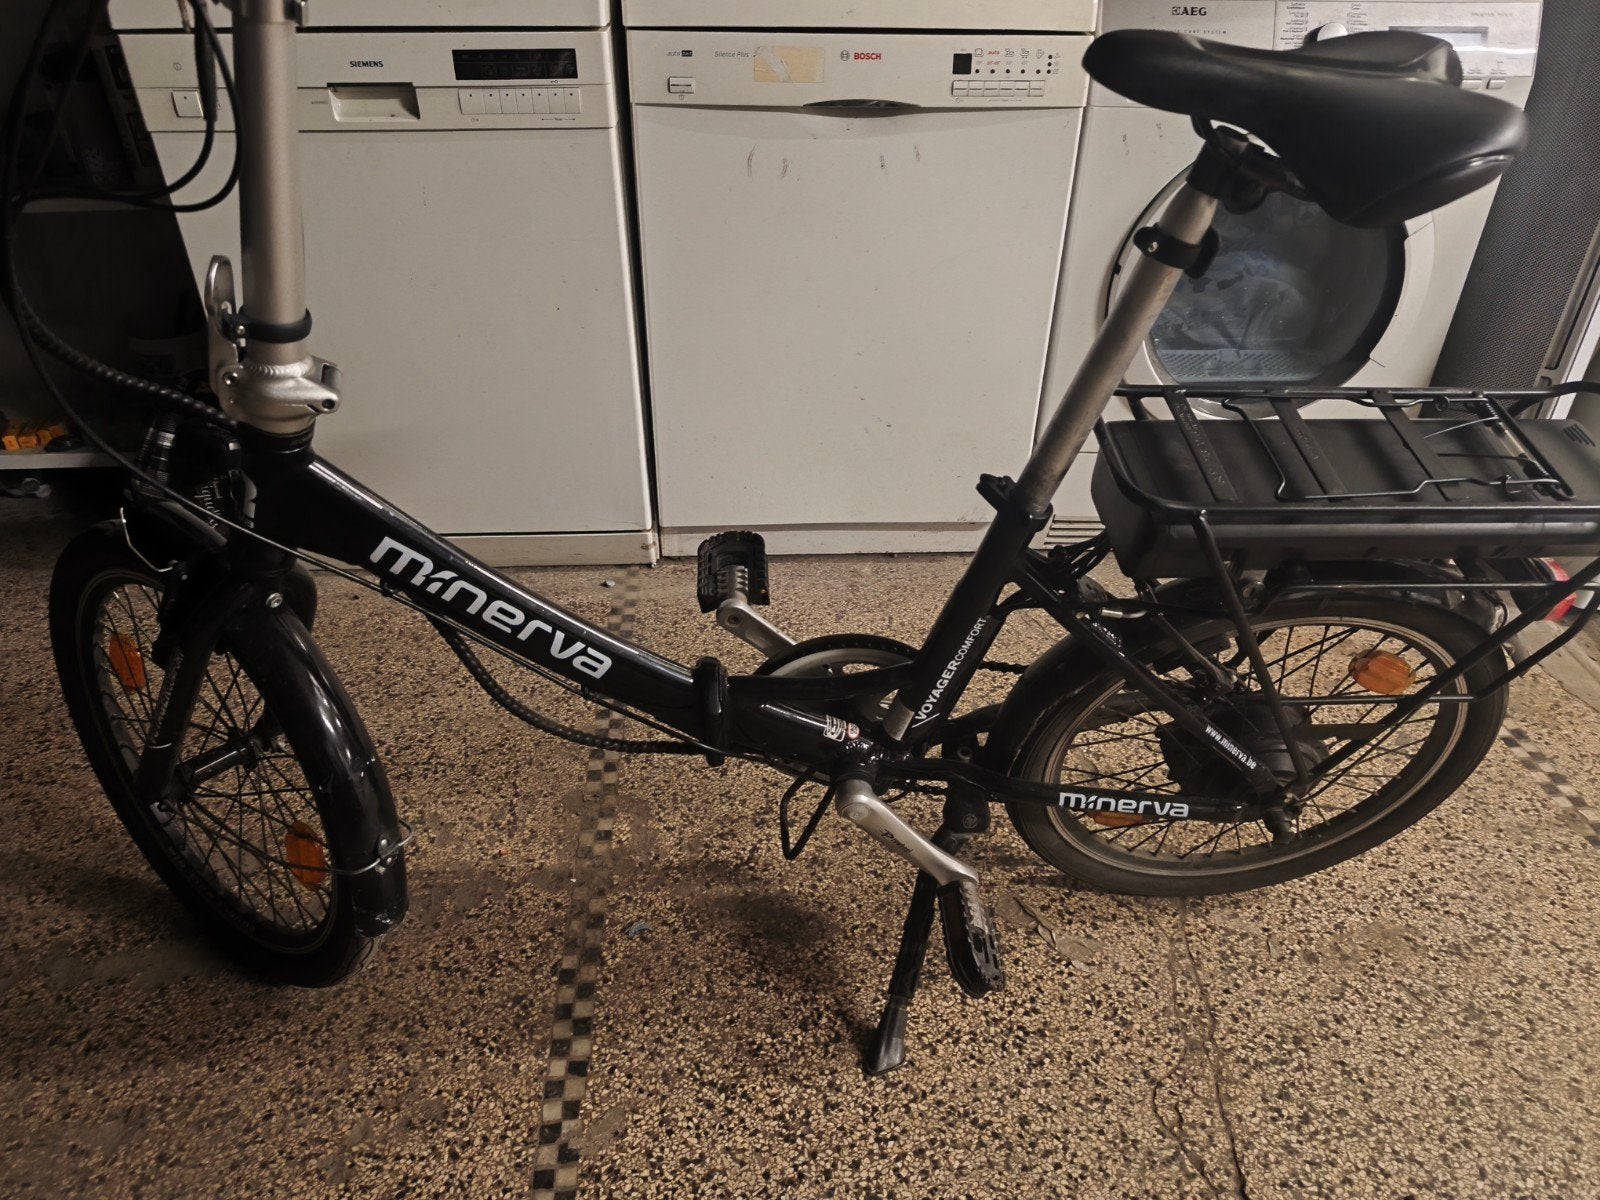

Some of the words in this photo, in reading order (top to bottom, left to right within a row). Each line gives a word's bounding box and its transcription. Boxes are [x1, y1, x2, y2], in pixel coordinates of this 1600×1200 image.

[1181, 6, 1207, 16] AEG
[350, 60, 384, 68] SIEMENS
[853, 52, 882, 61] BOSCH
[369, 536, 613, 679] minerva
[1205, 724, 1257, 770] www.minerva.be
[1058, 791, 1190, 818] minerva
